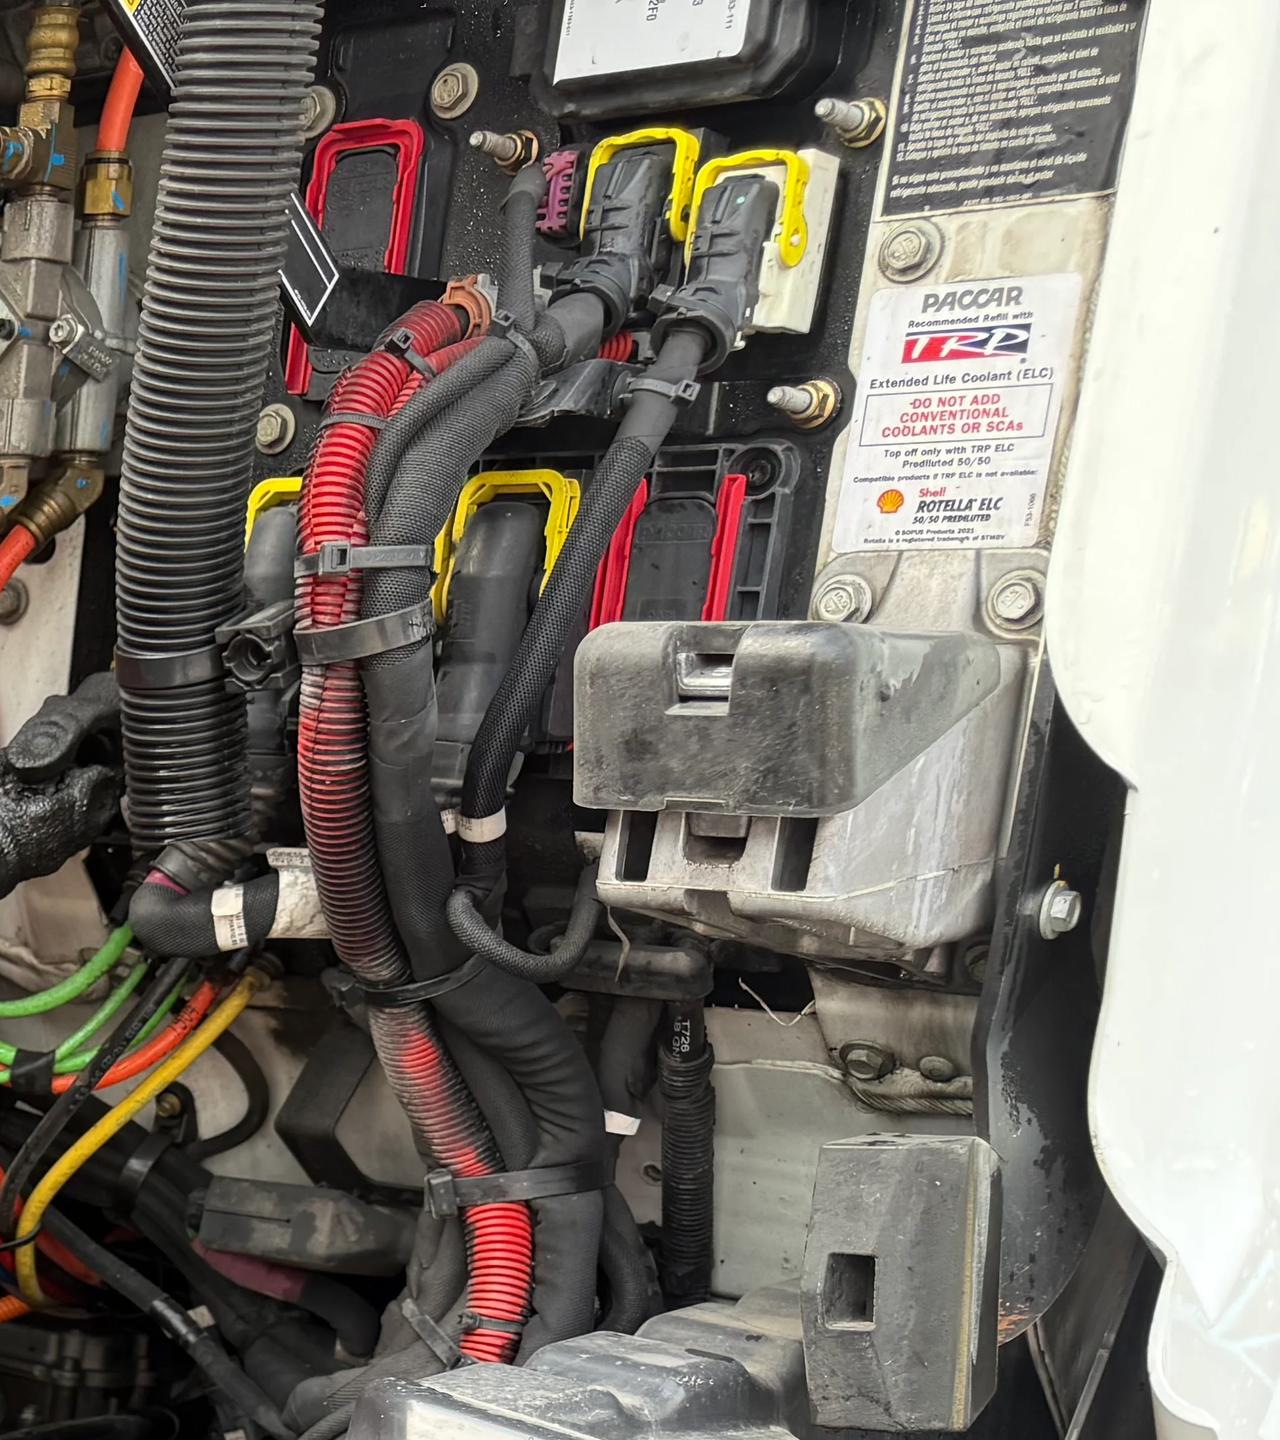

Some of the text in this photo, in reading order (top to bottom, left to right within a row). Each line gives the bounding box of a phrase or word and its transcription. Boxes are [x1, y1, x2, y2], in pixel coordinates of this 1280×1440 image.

[921, 286, 1024, 313] PACCAR
[908, 311, 1033, 329] Recommended Refill with
[904, 326, 1032, 362] TRP
[869, 367, 1054, 390] Extended Life Coolant (ELC)
[912, 394, 1001, 409] DO NOT ADD
[900, 406, 1009, 424] CONVENTIONAL
[881, 420, 1023, 438] COOLANTS OR SCAs
[884, 443, 1015, 460] Top off only with TRP ELC
[902, 457, 991, 469] Prediluted 50/50
[853, 475, 895, 484] Compatible
[897, 474, 930, 483] products
[919, 487, 946, 498] Shell
[916, 497, 1003, 514] ROTELLA ELC
[912, 514, 991, 525] 50/50 PREDILUTED
